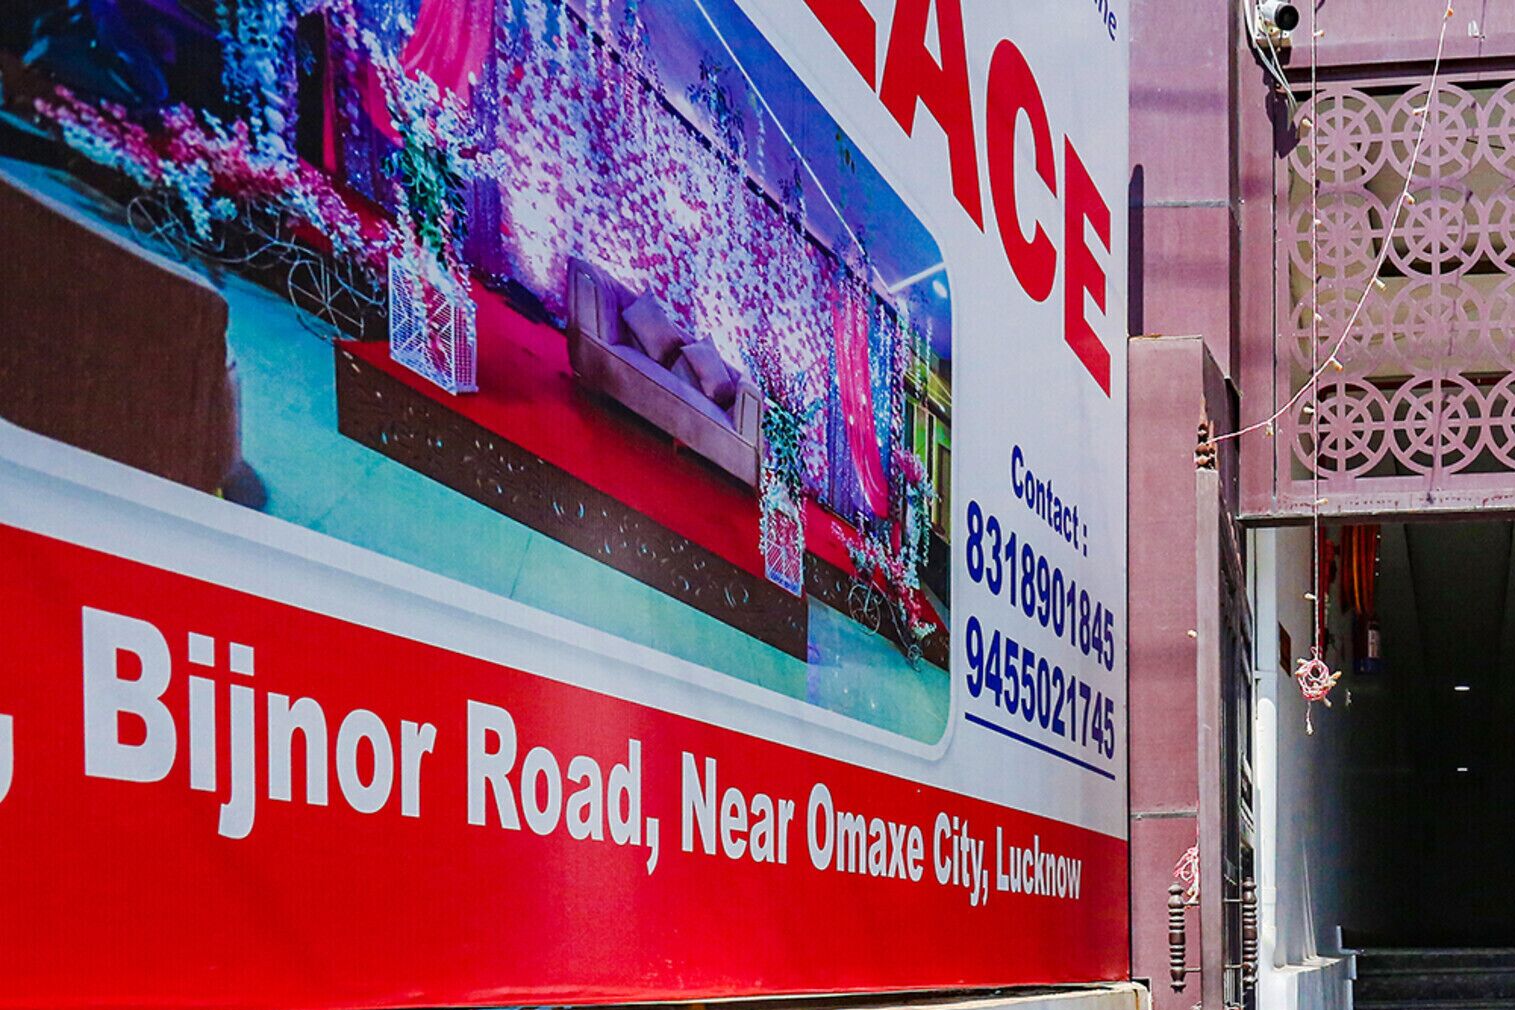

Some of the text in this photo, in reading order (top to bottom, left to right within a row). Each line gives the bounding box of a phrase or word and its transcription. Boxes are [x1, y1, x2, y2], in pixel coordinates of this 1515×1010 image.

[966, 501, 1114, 672] 8318901845
[82, 605, 437, 839] Bijnor
[467, 698, 660, 876] Road,
[682, 750, 795, 865] Near
[807, 782, 925, 883] Omaxe
[933, 811, 989, 908] City,
[996, 826, 1082, 900] Lucknow
[965, 616, 1115, 761] 9455021745
